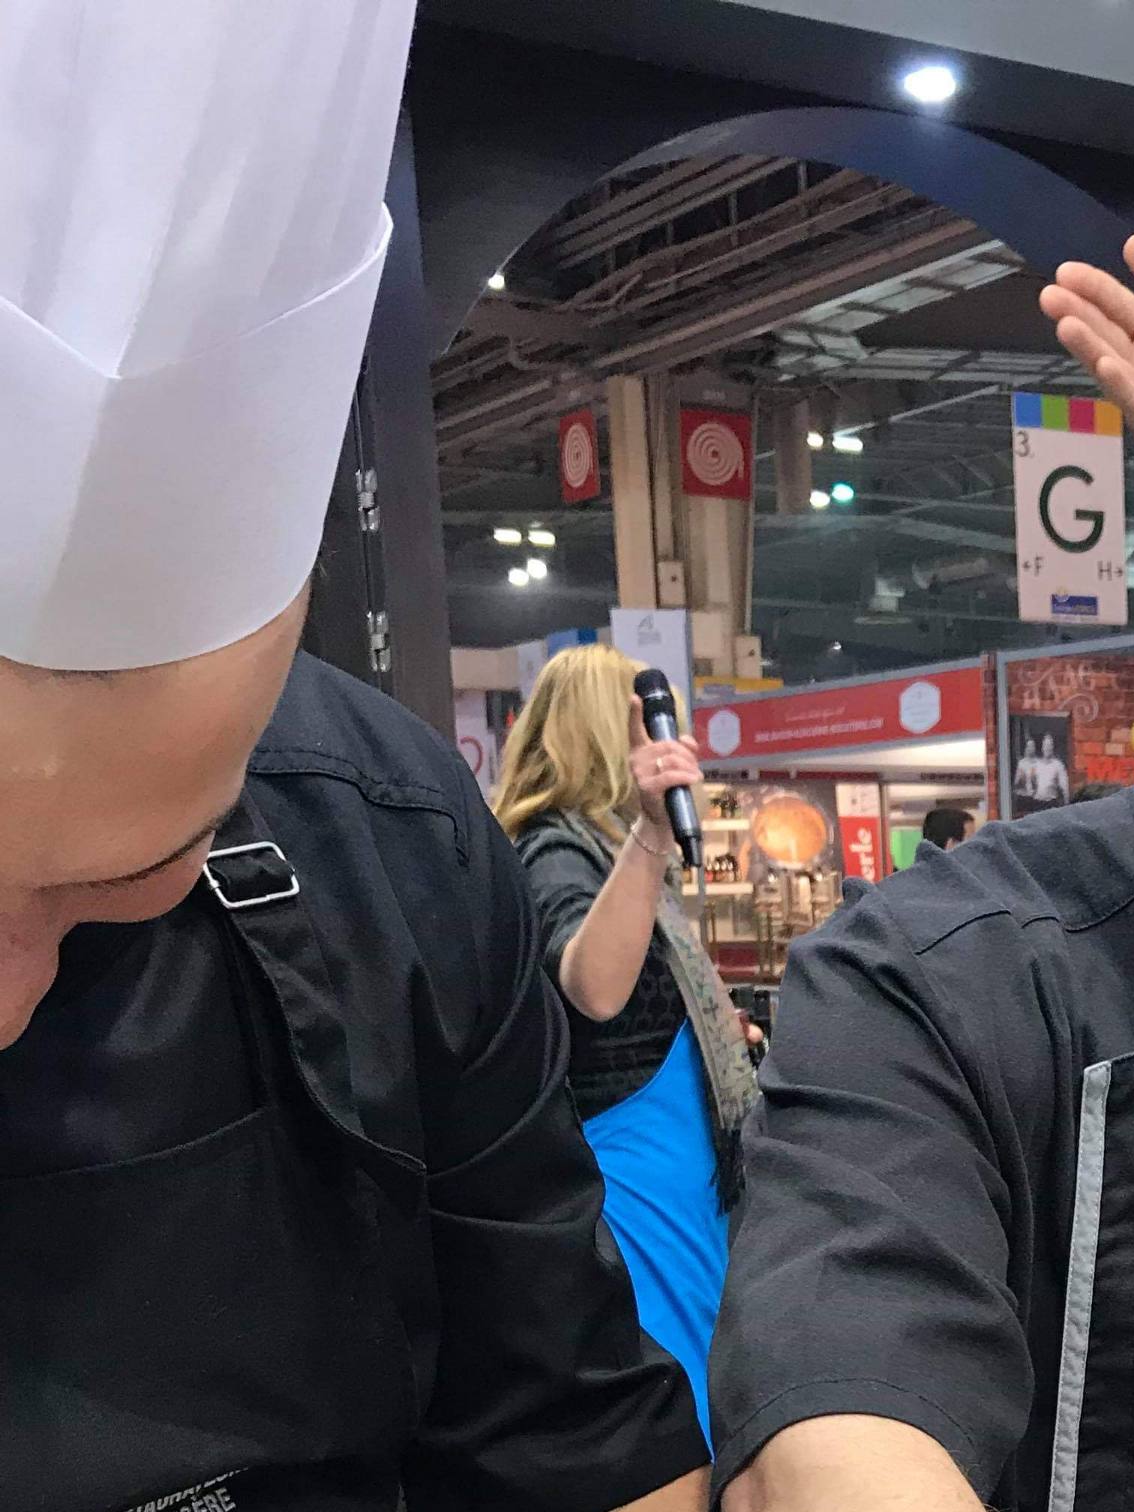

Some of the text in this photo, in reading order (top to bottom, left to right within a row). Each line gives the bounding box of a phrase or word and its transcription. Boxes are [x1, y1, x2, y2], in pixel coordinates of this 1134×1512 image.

[1039, 464, 1105, 554] G
[1034, 555, 1113, 581] F H
